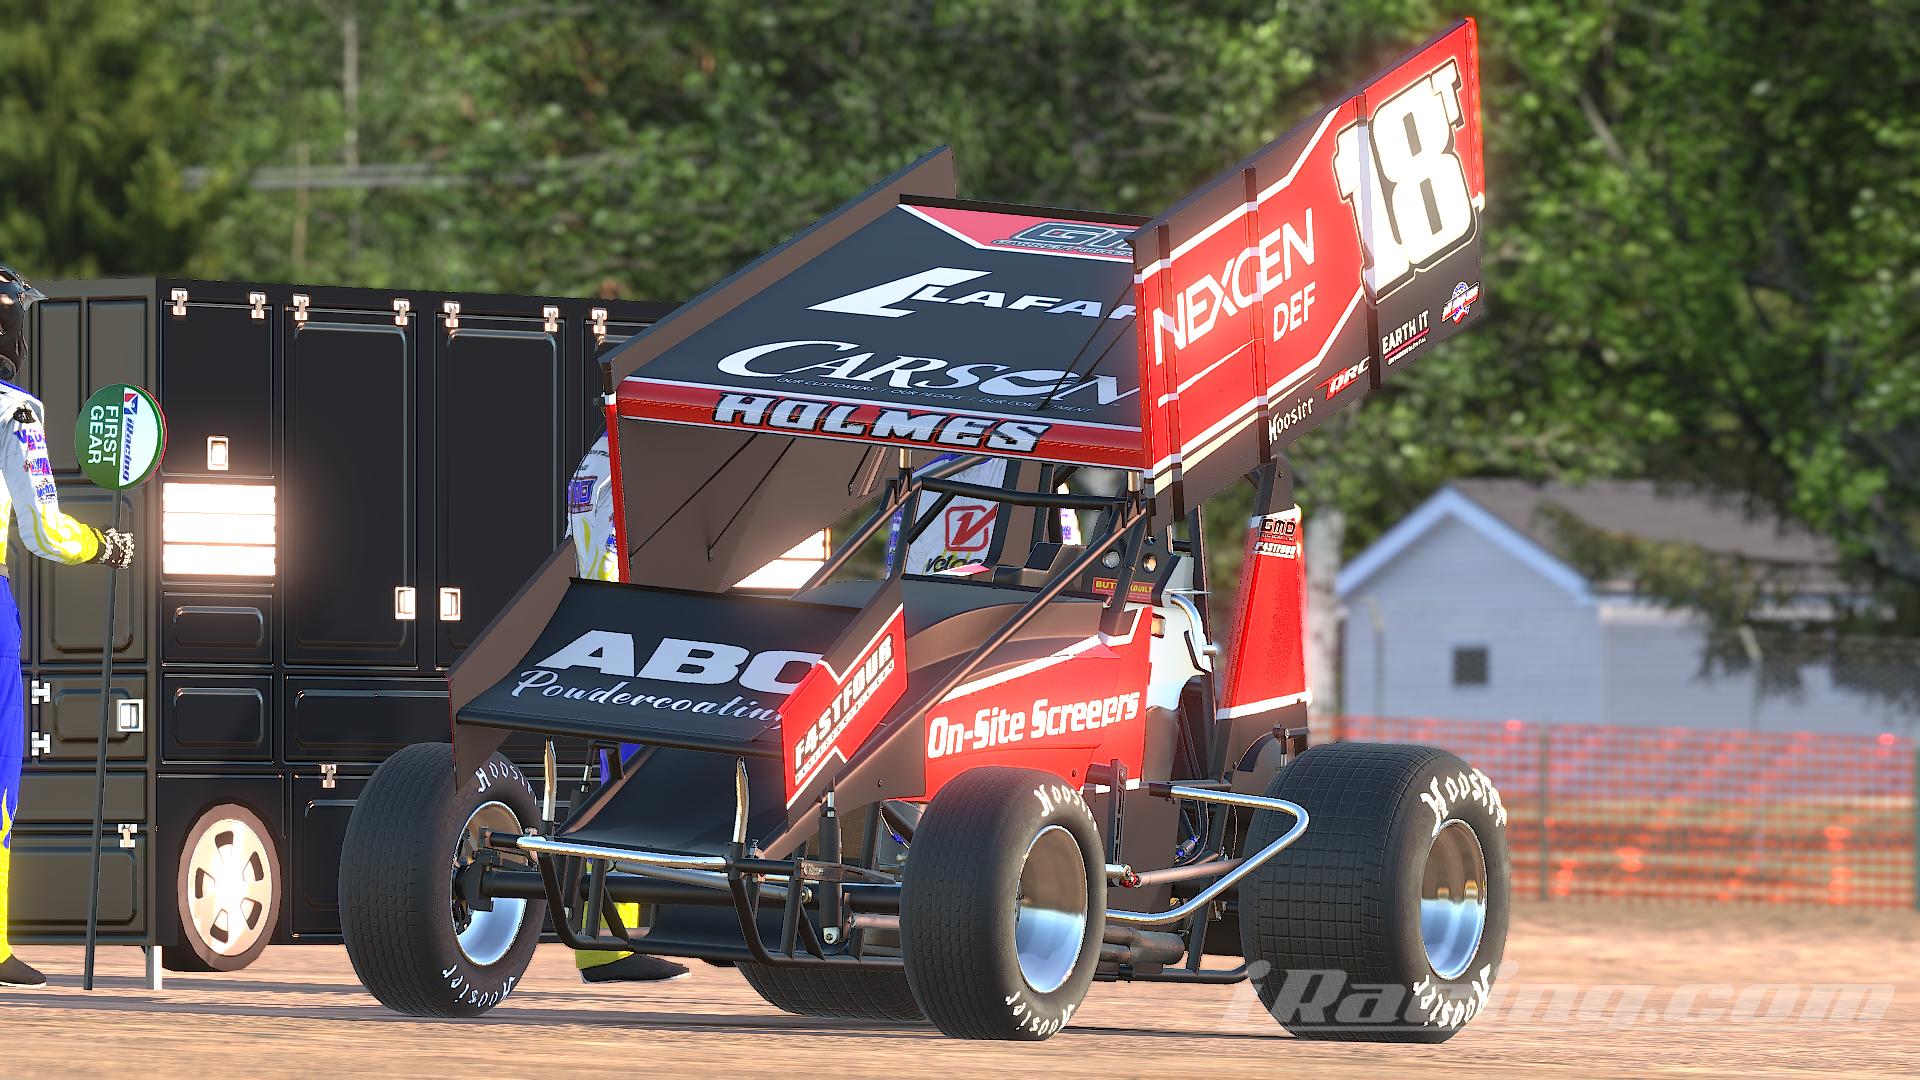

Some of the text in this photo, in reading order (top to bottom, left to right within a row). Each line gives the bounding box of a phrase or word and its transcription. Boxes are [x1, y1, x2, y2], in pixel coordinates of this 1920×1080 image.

[1152, 206, 1316, 367] NEXGEN
[1273, 280, 1317, 343] DEF
[1382, 318, 1418, 355] EARTH
[1418, 309, 1429, 332] IT
[717, 339, 1141, 406] CARSON
[88, 405, 105, 464] GEAR
[103, 405, 119, 467] FIRST
[713, 392, 1052, 452] HOLMES
[927, 706, 1026, 759] On-Site
